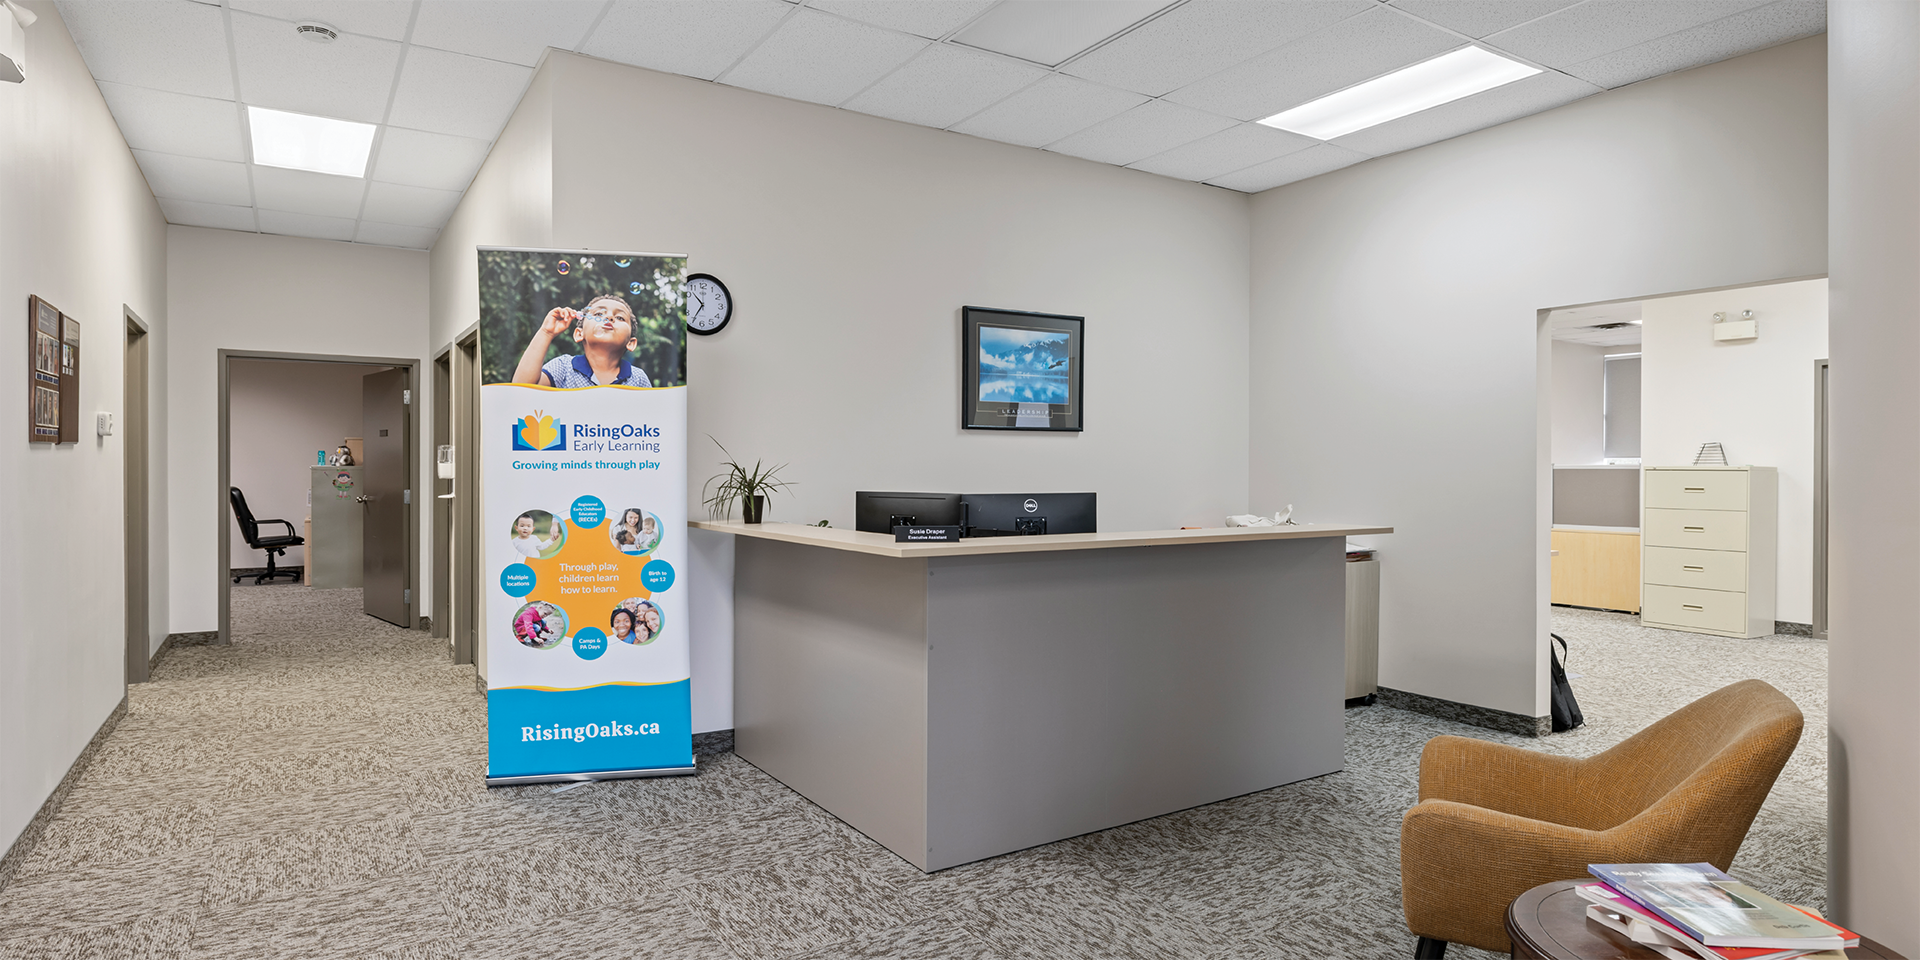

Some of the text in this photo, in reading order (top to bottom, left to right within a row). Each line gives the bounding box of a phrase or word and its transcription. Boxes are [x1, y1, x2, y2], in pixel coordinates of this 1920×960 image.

[574, 424, 660, 440] RisingOaks
[574, 440, 660, 453] Early Learning
[512, 460, 660, 472] Growing minds through play
[559, 562, 619, 572] Through play,
[558, 573, 619, 583] children learn
[560, 584, 618, 594] how to learn.
[521, 720, 660, 742] RisingOaks.ca
